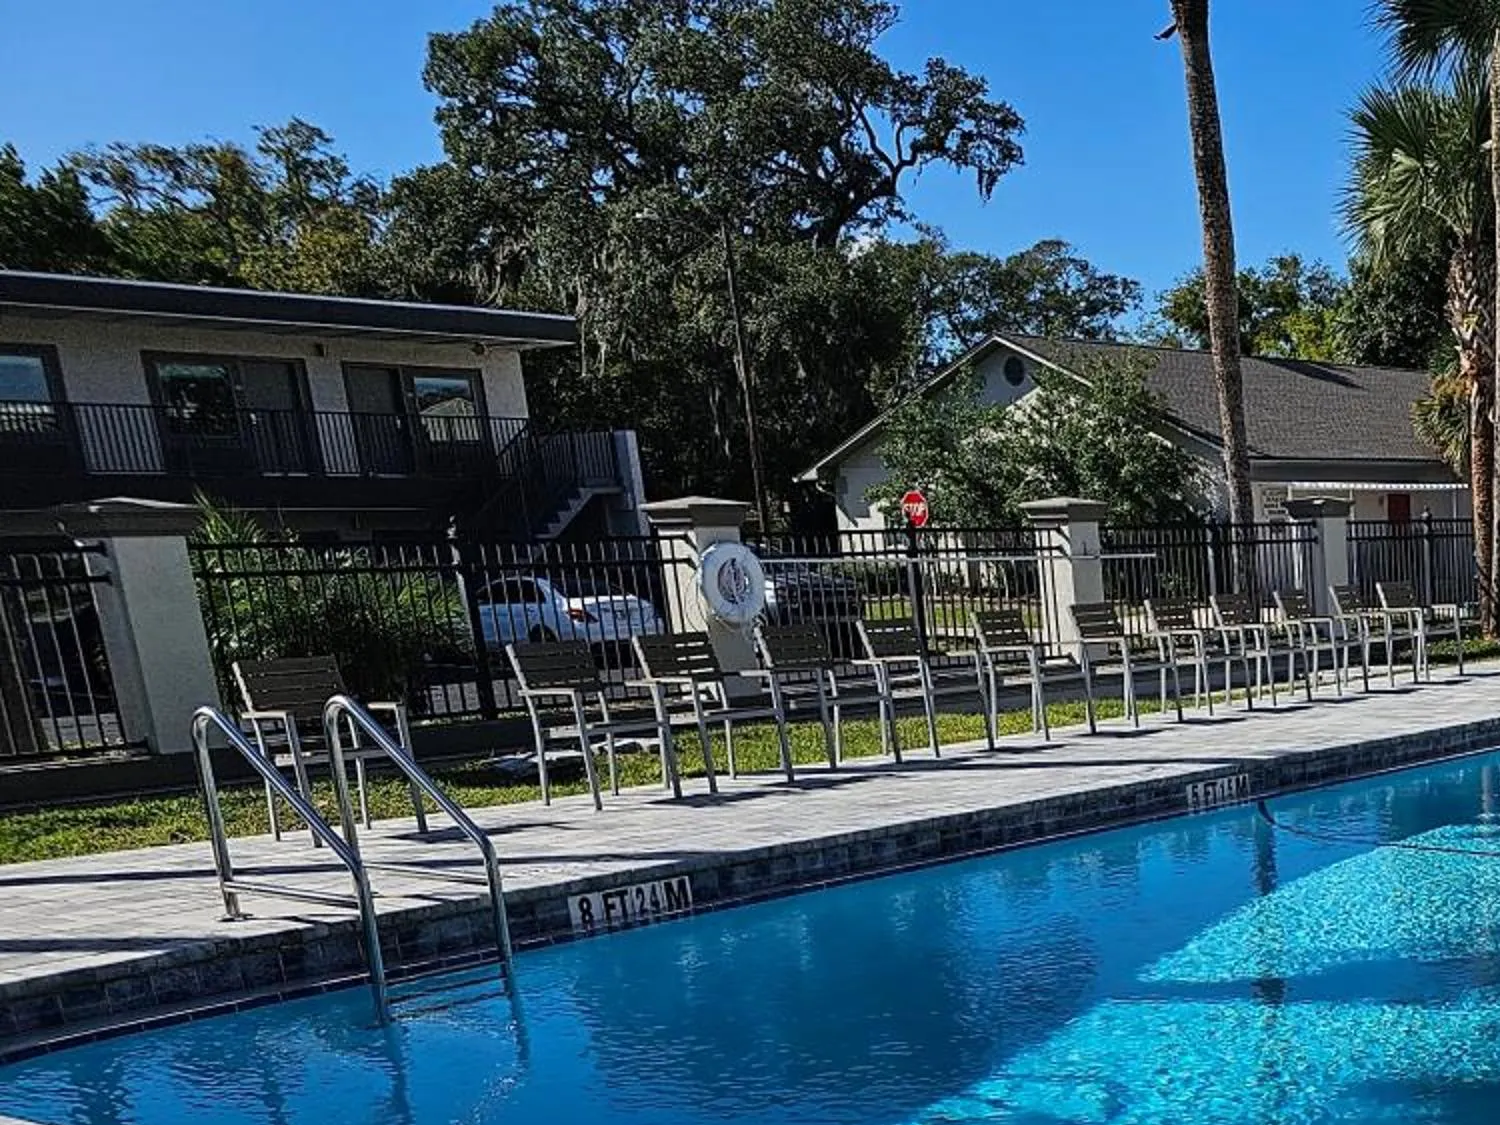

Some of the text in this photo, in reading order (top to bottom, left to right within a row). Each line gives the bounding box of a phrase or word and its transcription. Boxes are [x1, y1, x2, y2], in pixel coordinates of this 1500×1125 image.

[904, 503, 926, 517] STOP
[578, 896, 594, 926] 8
[602, 889, 628, 923] FT
